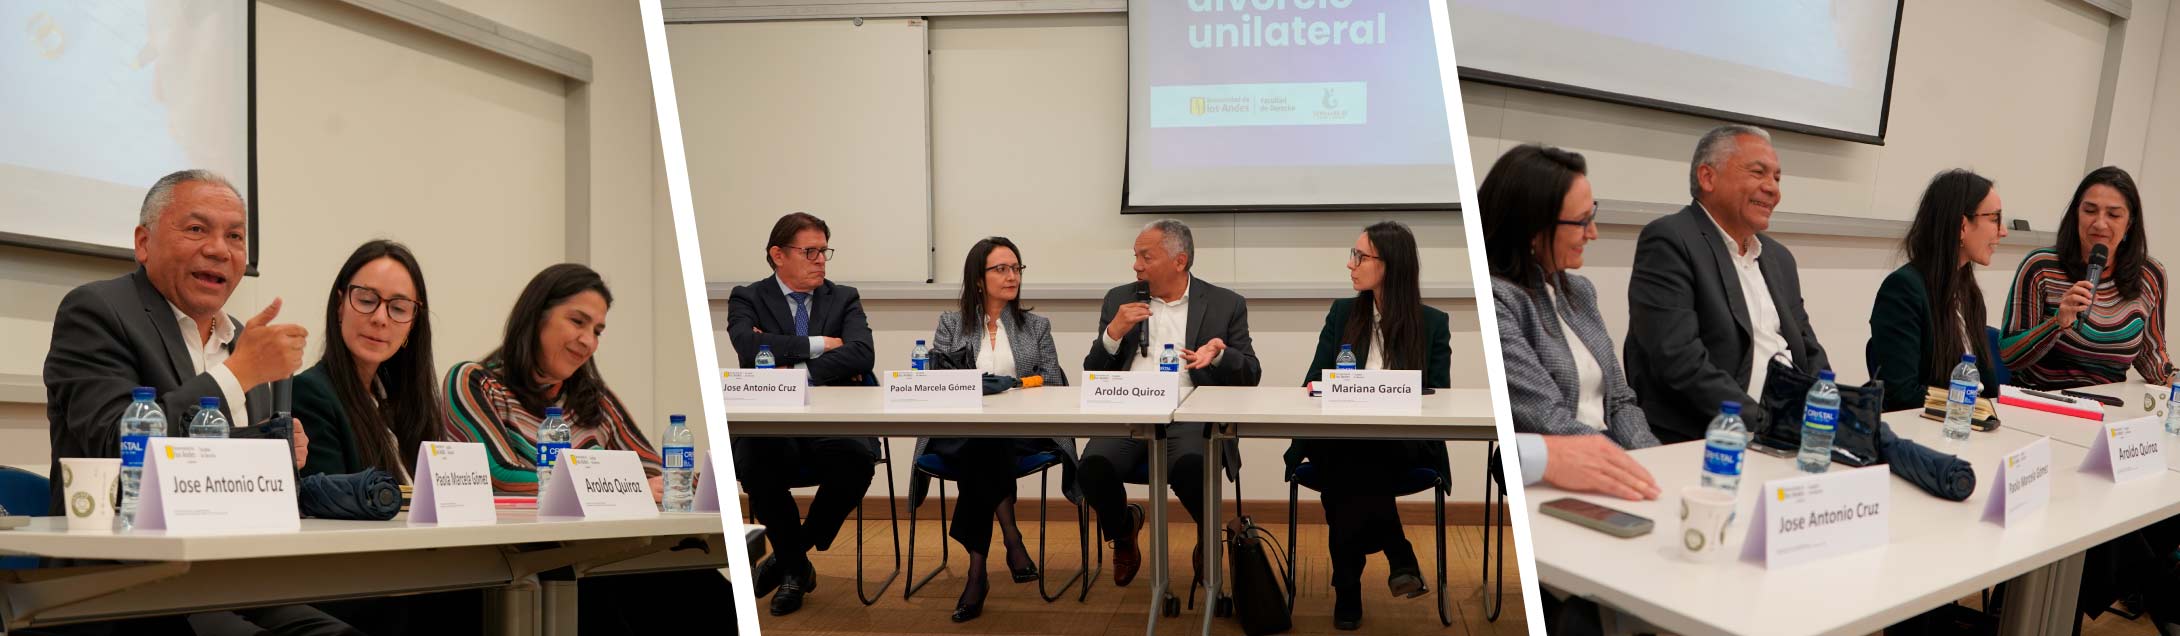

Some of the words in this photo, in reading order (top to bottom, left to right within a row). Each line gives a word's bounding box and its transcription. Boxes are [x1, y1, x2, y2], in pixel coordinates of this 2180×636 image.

[1188, 12, 1386, 48] unilateral
[723, 383, 741, 392] Jose
[743, 383, 776, 392] Antonio
[778, 383, 797, 392] Cruz
[890, 384, 912, 392] Paola
[914, 383, 946, 392] Marcela
[948, 383, 976, 391] Gómez
[1094, 386, 1129, 396] Aroldo
[1132, 387, 1166, 397] Quiroz
[1332, 384, 1376, 393] Mariana
[1378, 383, 1411, 394] García
[2119, 445, 2139, 460] Aroldo
[2140, 442, 2158, 456] Quiroz
[174, 475, 201, 494] Jose
[205, 475, 254, 494] Antonio
[257, 475, 284, 493] Cruz
[435, 472, 451, 487] Paola
[451, 472, 471, 486] Marcela
[585, 477, 614, 493] Aroldo
[614, 477, 643, 495] Quiroz
[1779, 516, 1805, 534] Jose
[1808, 504, 1854, 528] Antonio
[1856, 502, 1880, 519] Cruz
